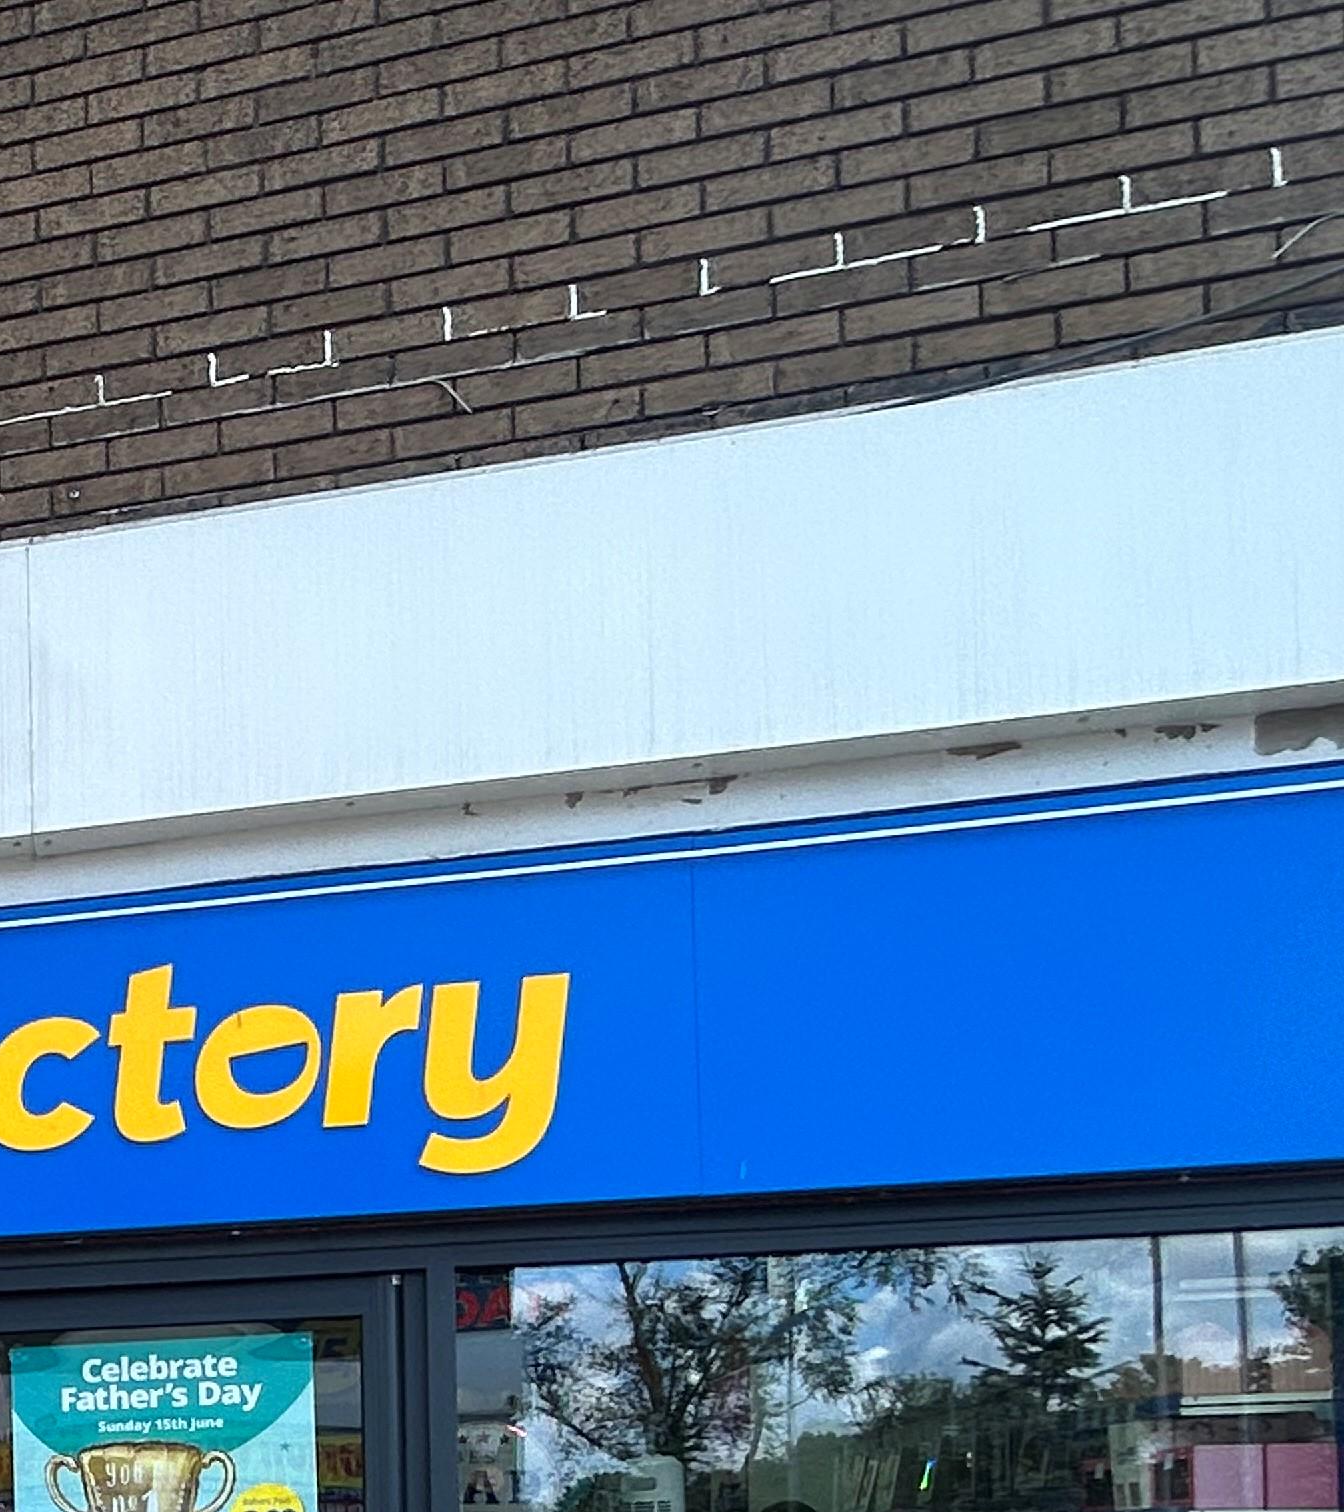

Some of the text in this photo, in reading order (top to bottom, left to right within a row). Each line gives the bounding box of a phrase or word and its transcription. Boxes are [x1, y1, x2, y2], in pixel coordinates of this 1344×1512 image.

[81, 1353, 238, 1384] Celebrate
[61, 1380, 263, 1413] Father's Day
[97, 1416, 224, 1434] Sunday 15th June
